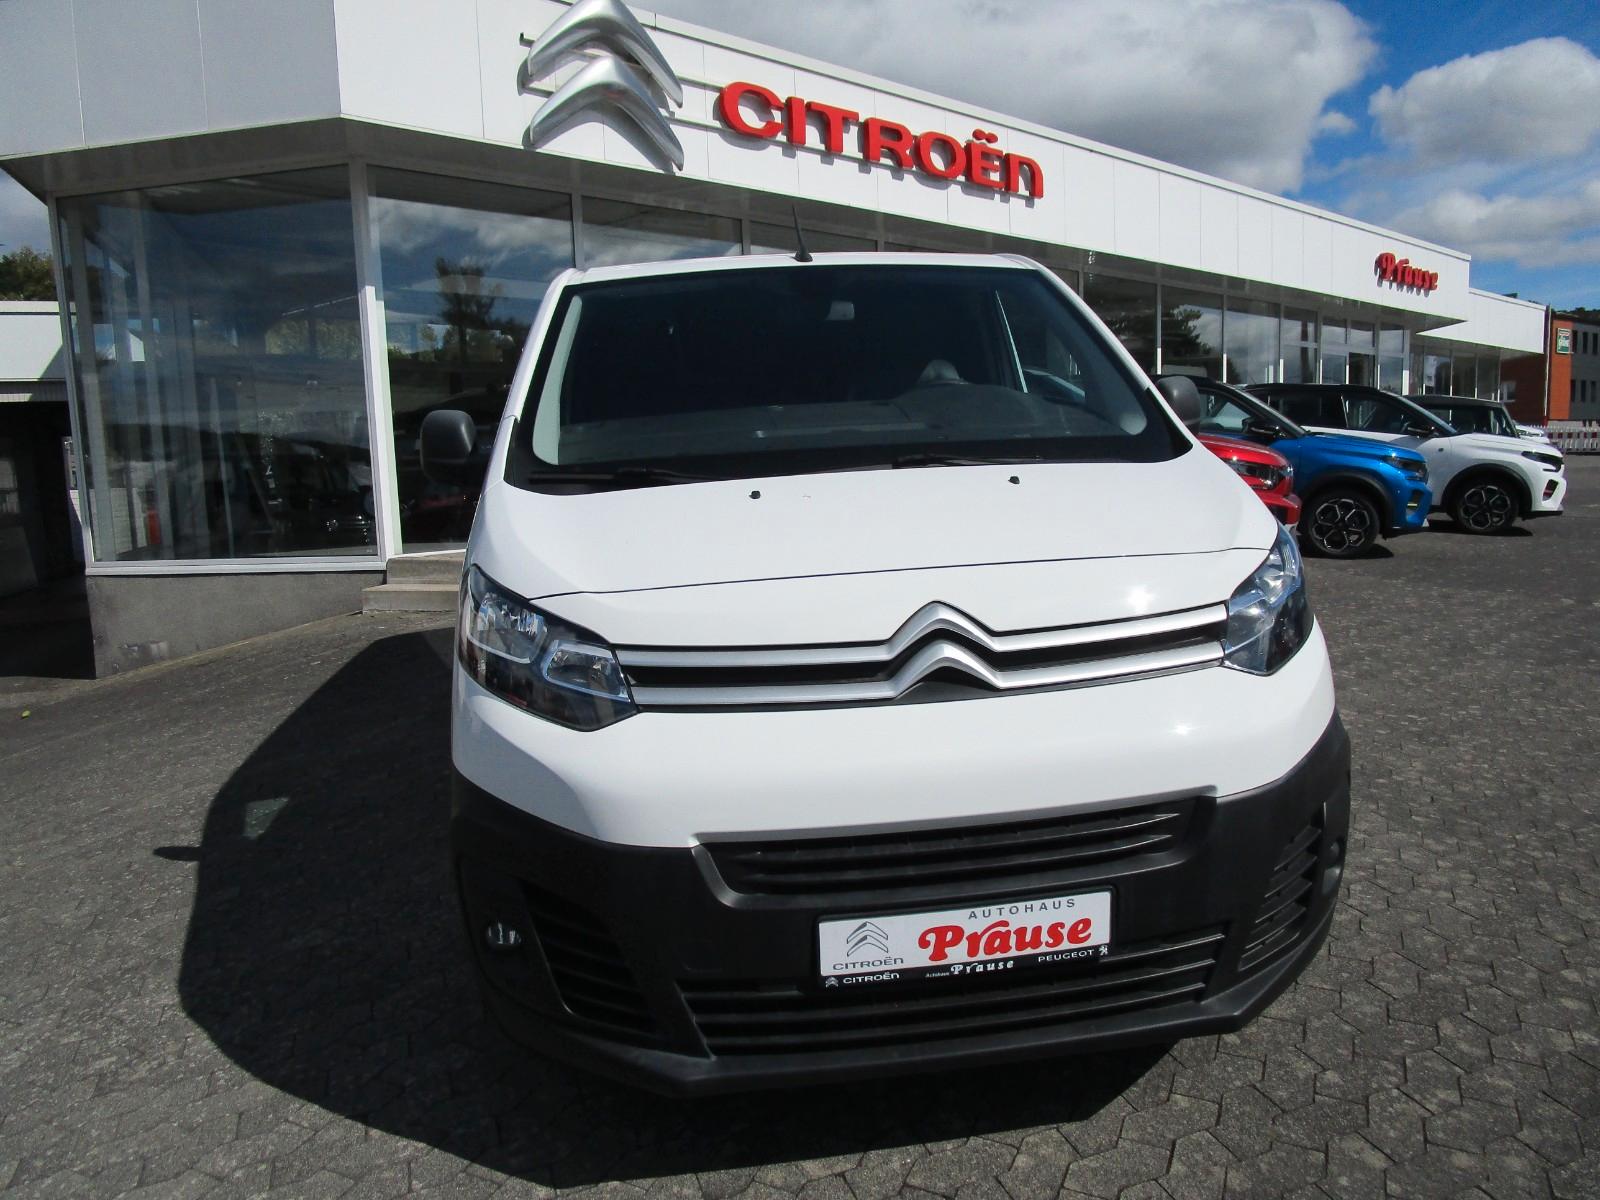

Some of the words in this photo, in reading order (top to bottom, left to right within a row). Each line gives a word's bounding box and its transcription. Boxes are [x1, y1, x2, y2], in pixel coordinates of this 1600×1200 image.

[1377, 252, 1439, 291] Prause
[968, 898, 1076, 920] AUTOHAUS
[918, 917, 1093, 962] Prause
[950, 959, 1014, 975] Prause
[1038, 949, 1095, 963] PEUGEOT
